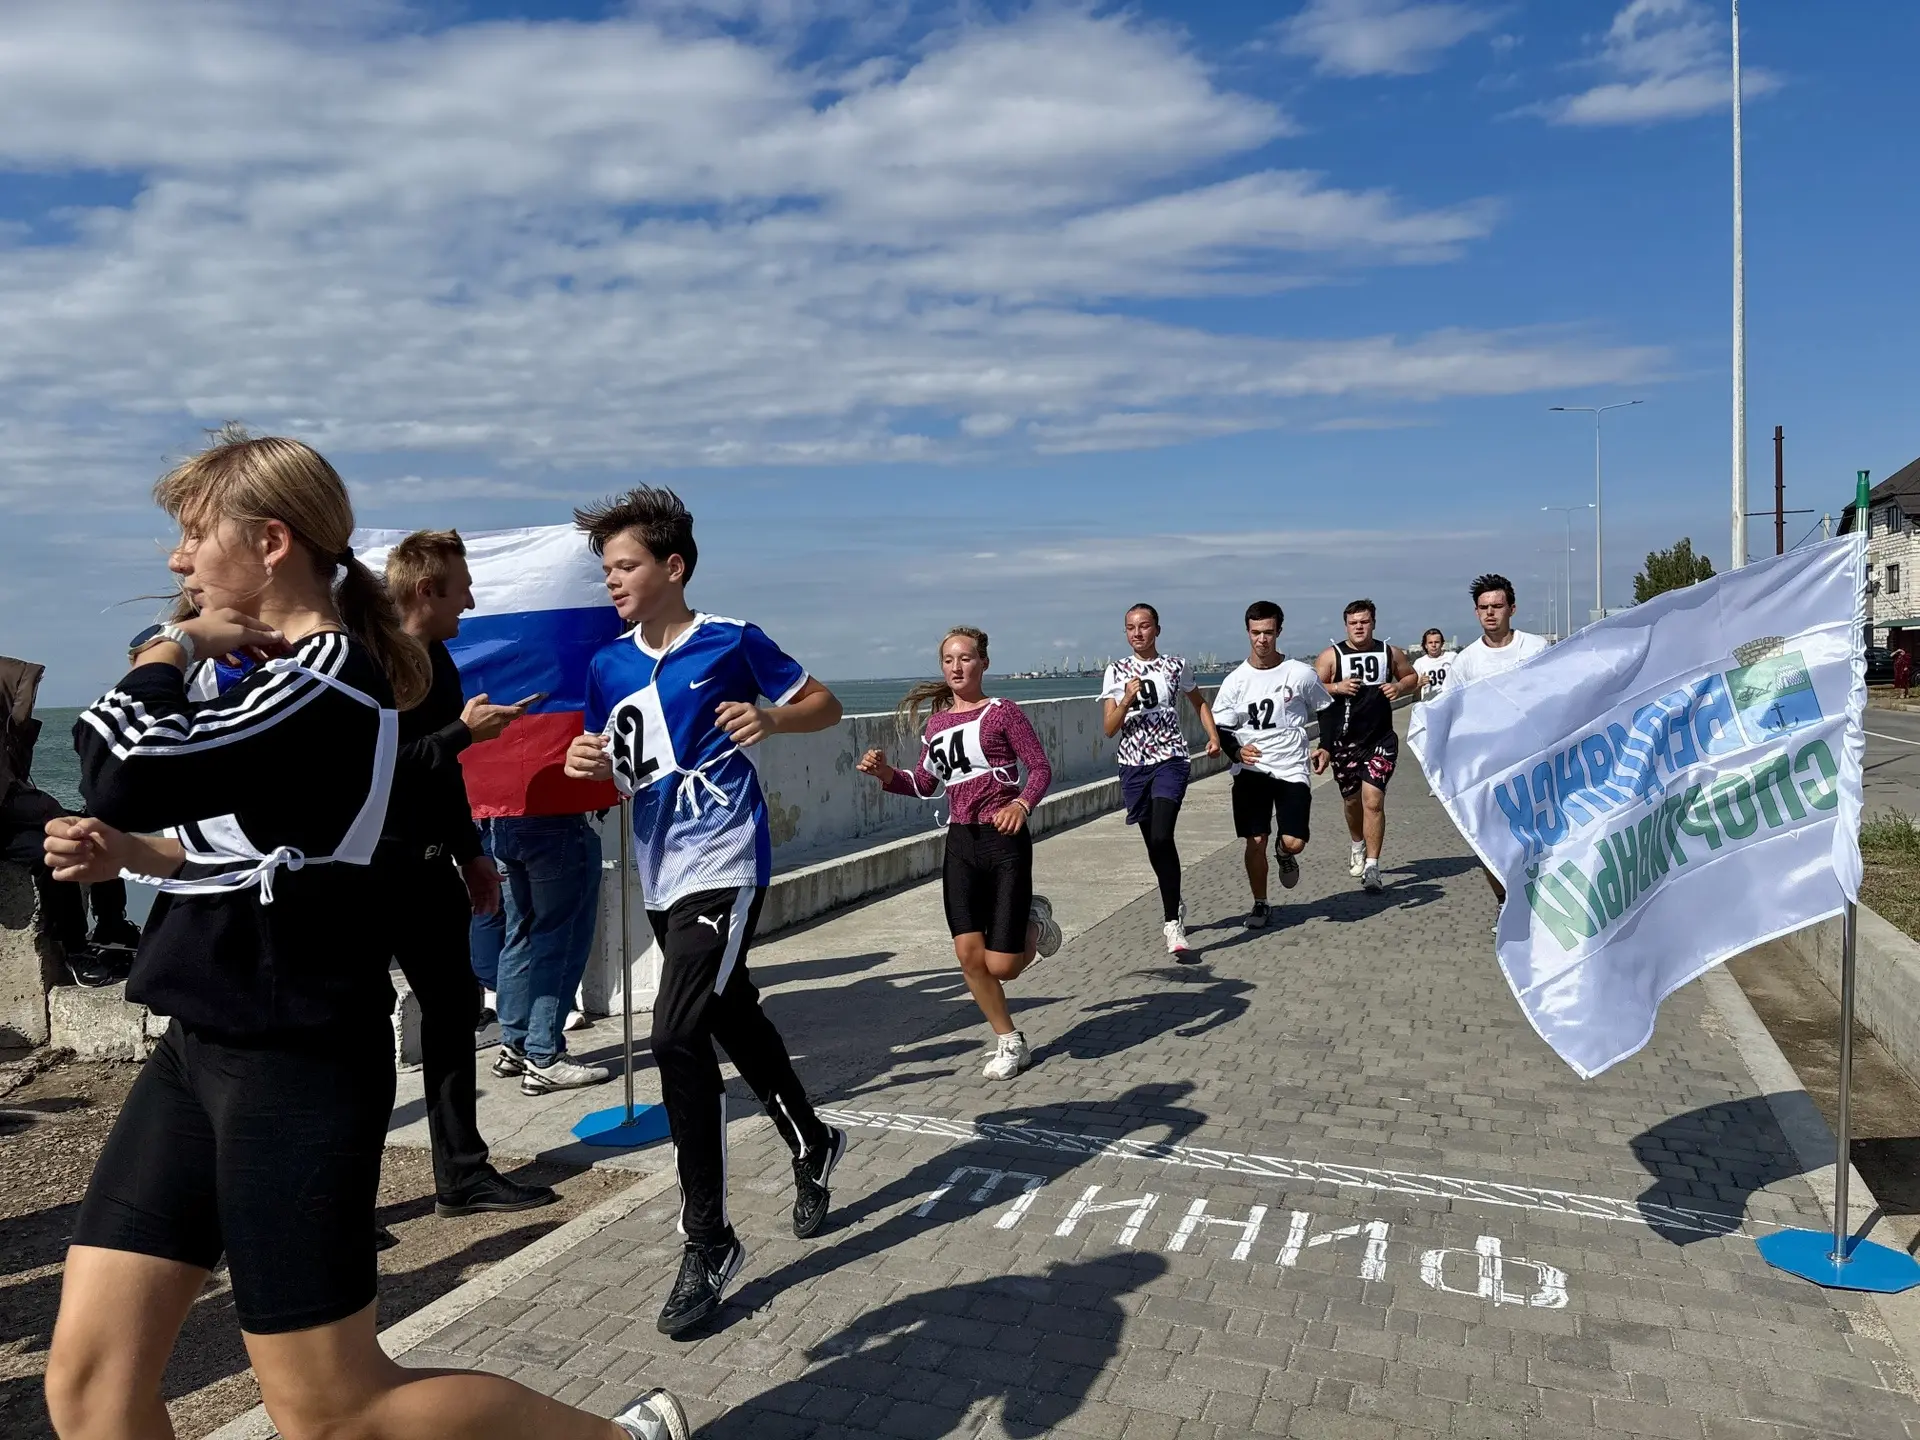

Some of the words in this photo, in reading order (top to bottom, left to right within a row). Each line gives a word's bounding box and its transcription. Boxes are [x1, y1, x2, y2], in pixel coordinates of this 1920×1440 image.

[1349, 655, 1379, 683] 59
[1428, 668, 1446, 687] 39
[1247, 698, 1277, 731] 42
[613, 704, 660, 787] 52
[929, 729, 973, 781] 54
[915, 1165, 1569, 1308] ФИНИШ
